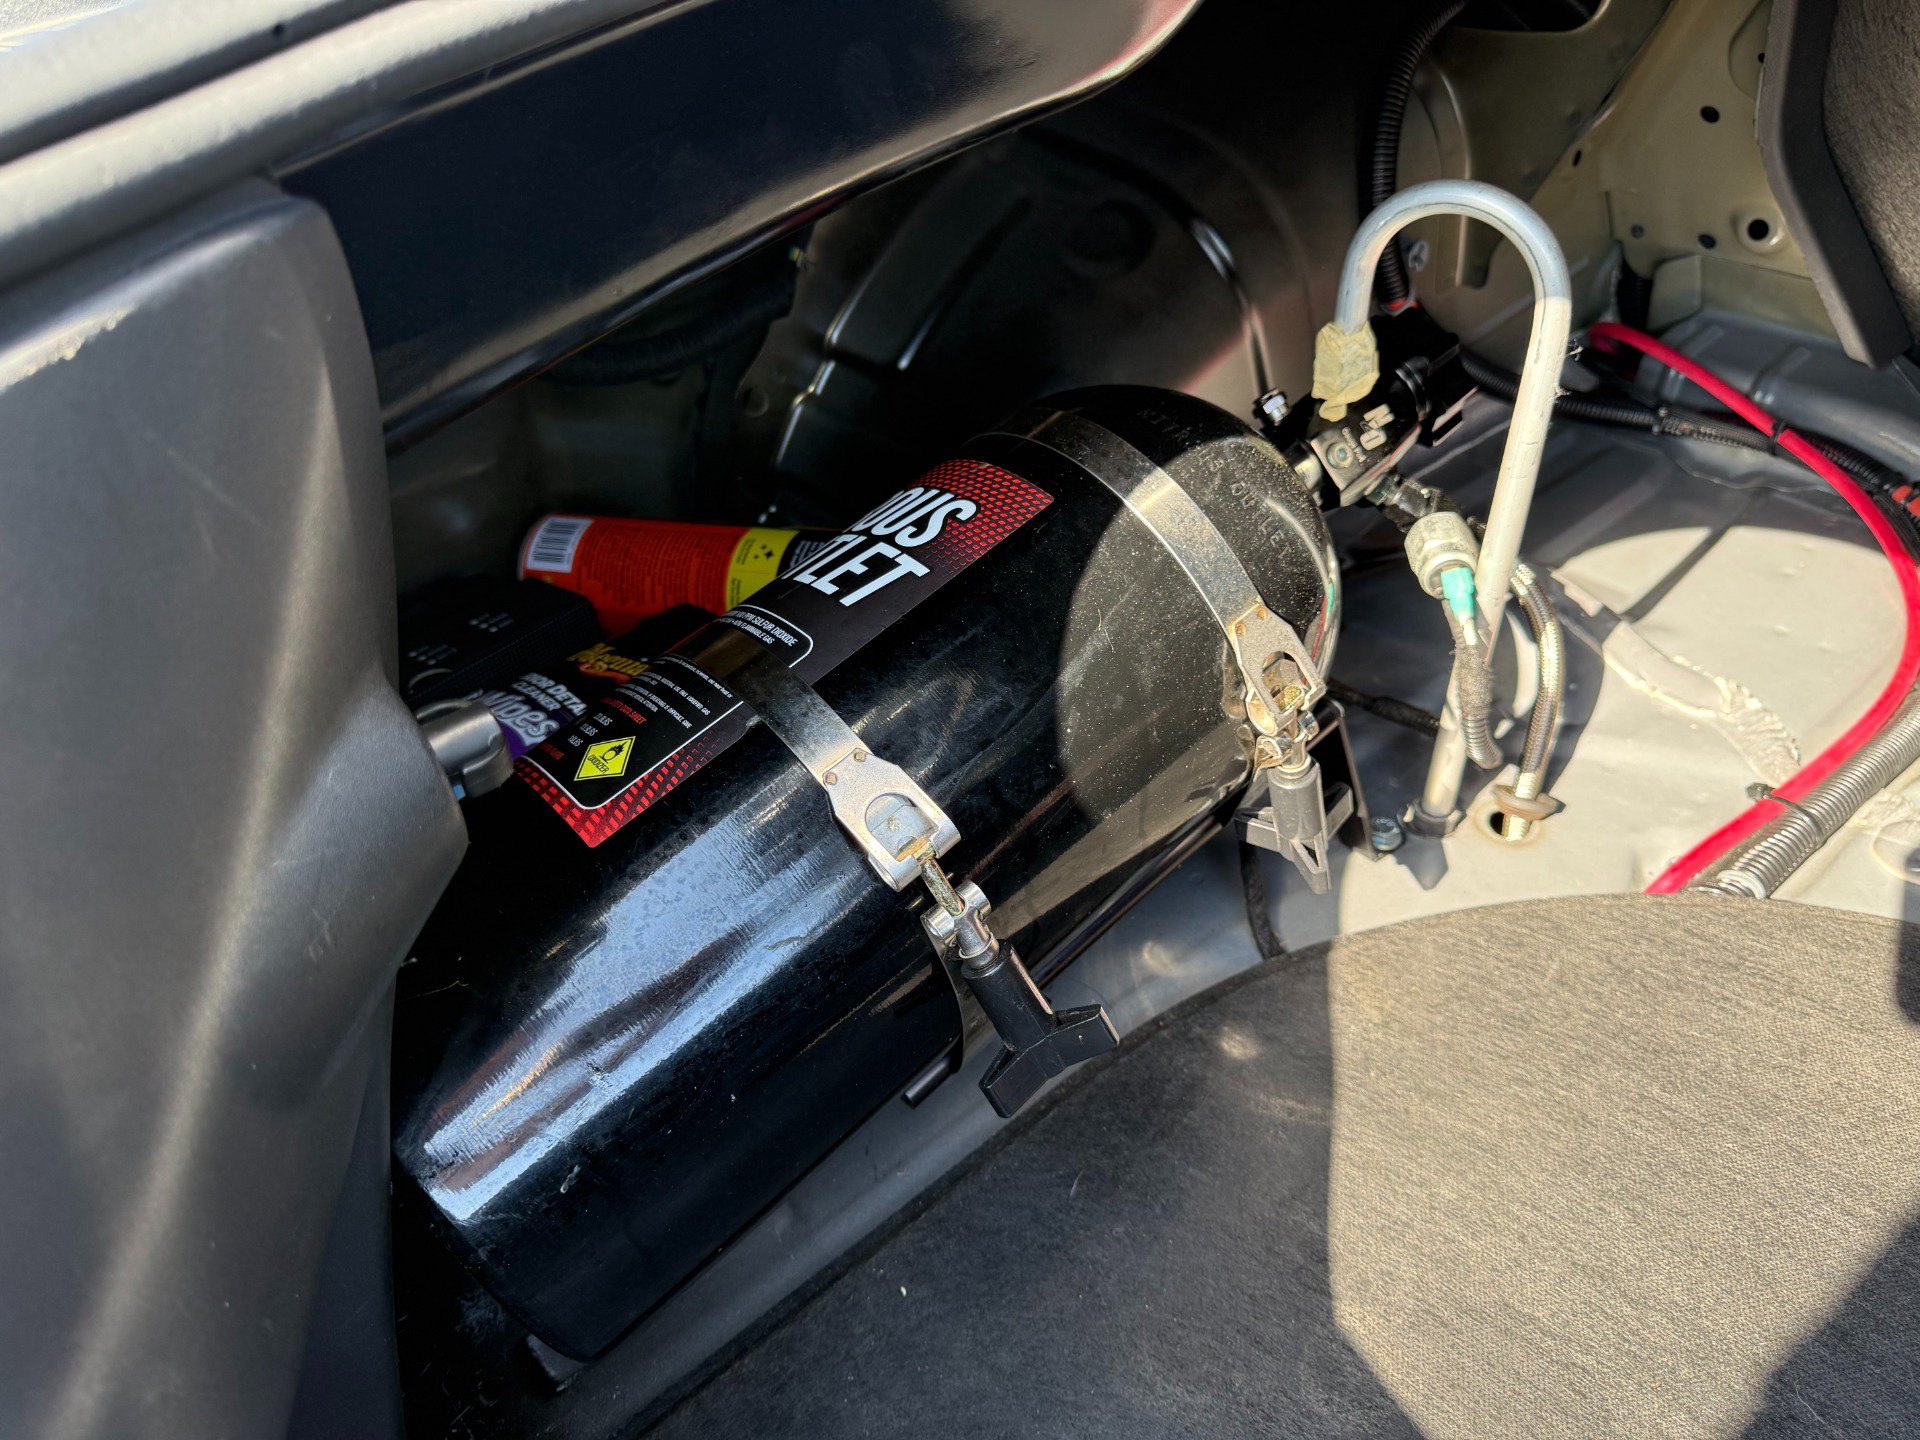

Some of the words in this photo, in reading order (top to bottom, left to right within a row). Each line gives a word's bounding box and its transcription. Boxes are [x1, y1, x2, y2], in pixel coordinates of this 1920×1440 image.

[752, 616, 775, 632] SULFUR
[770, 626, 799, 647] DIOXIDE
[762, 634, 775, 645] GAS
[511, 681, 561, 711] CLEANER
[629, 710, 647, 725] SHEET
[701, 705, 711, 716] GAS
[587, 754, 610, 775] OXIDIZER
